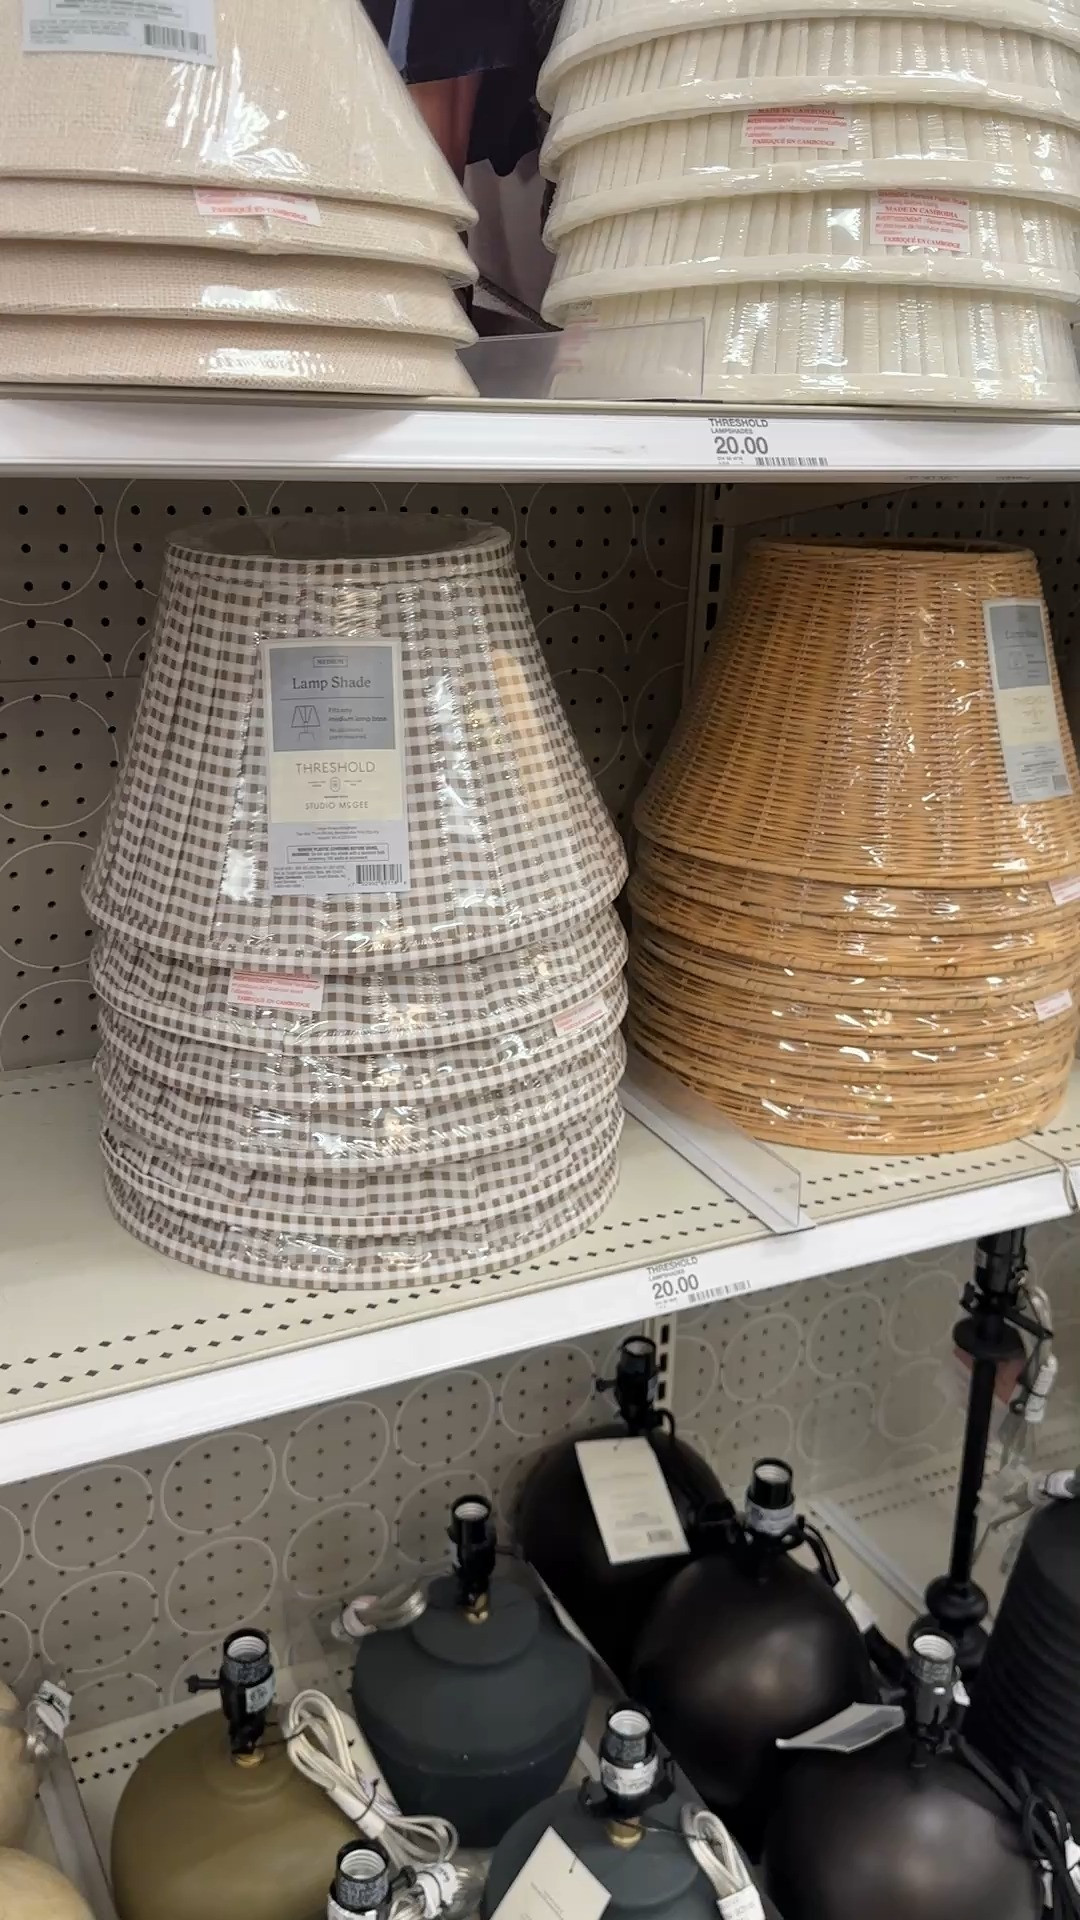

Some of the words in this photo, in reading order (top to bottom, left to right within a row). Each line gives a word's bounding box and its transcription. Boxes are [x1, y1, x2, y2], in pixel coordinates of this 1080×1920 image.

[708, 418, 769, 427] THRESHOLD
[714, 436, 769, 455] 20.00
[292, 677, 328, 691] Lamp
[331, 676, 371, 688] Shade
[296, 761, 376, 774] THRESHOLD
[305, 802, 336, 810] STUDIO
[647, 1256, 698, 1274] THRESHOLD
[652, 1274, 699, 1299] 20.00
